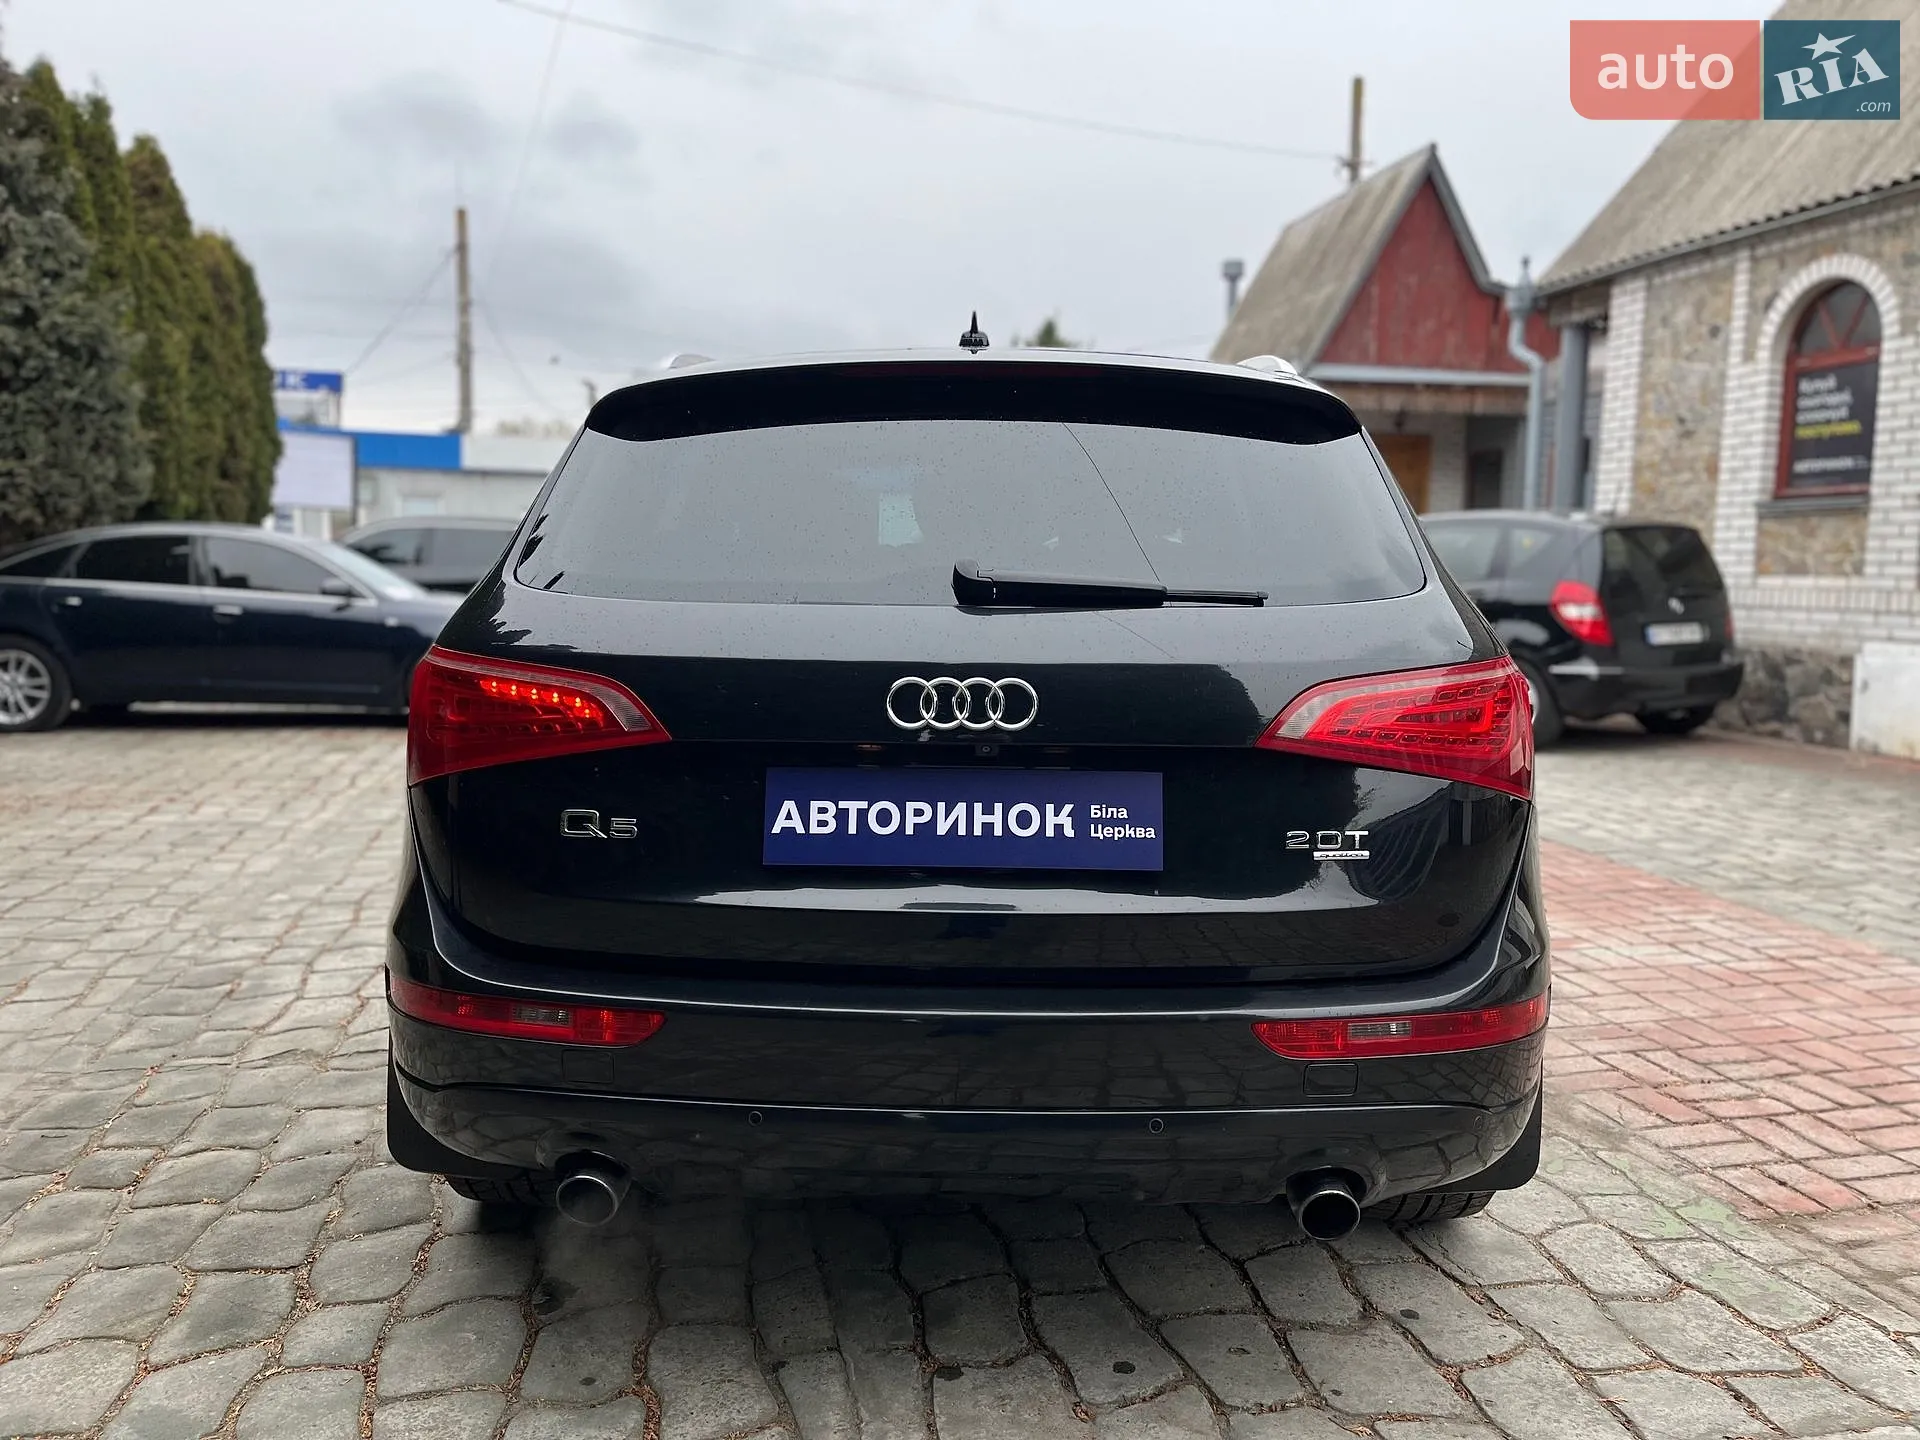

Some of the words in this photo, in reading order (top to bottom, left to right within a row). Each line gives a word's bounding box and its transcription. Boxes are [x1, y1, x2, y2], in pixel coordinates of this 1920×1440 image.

[560, 808, 638, 839] Q5
[770, 800, 1075, 838] АВТОРИНОК
[1090, 804, 1128, 819] Біла
[1090, 823, 1156, 841] Церква
